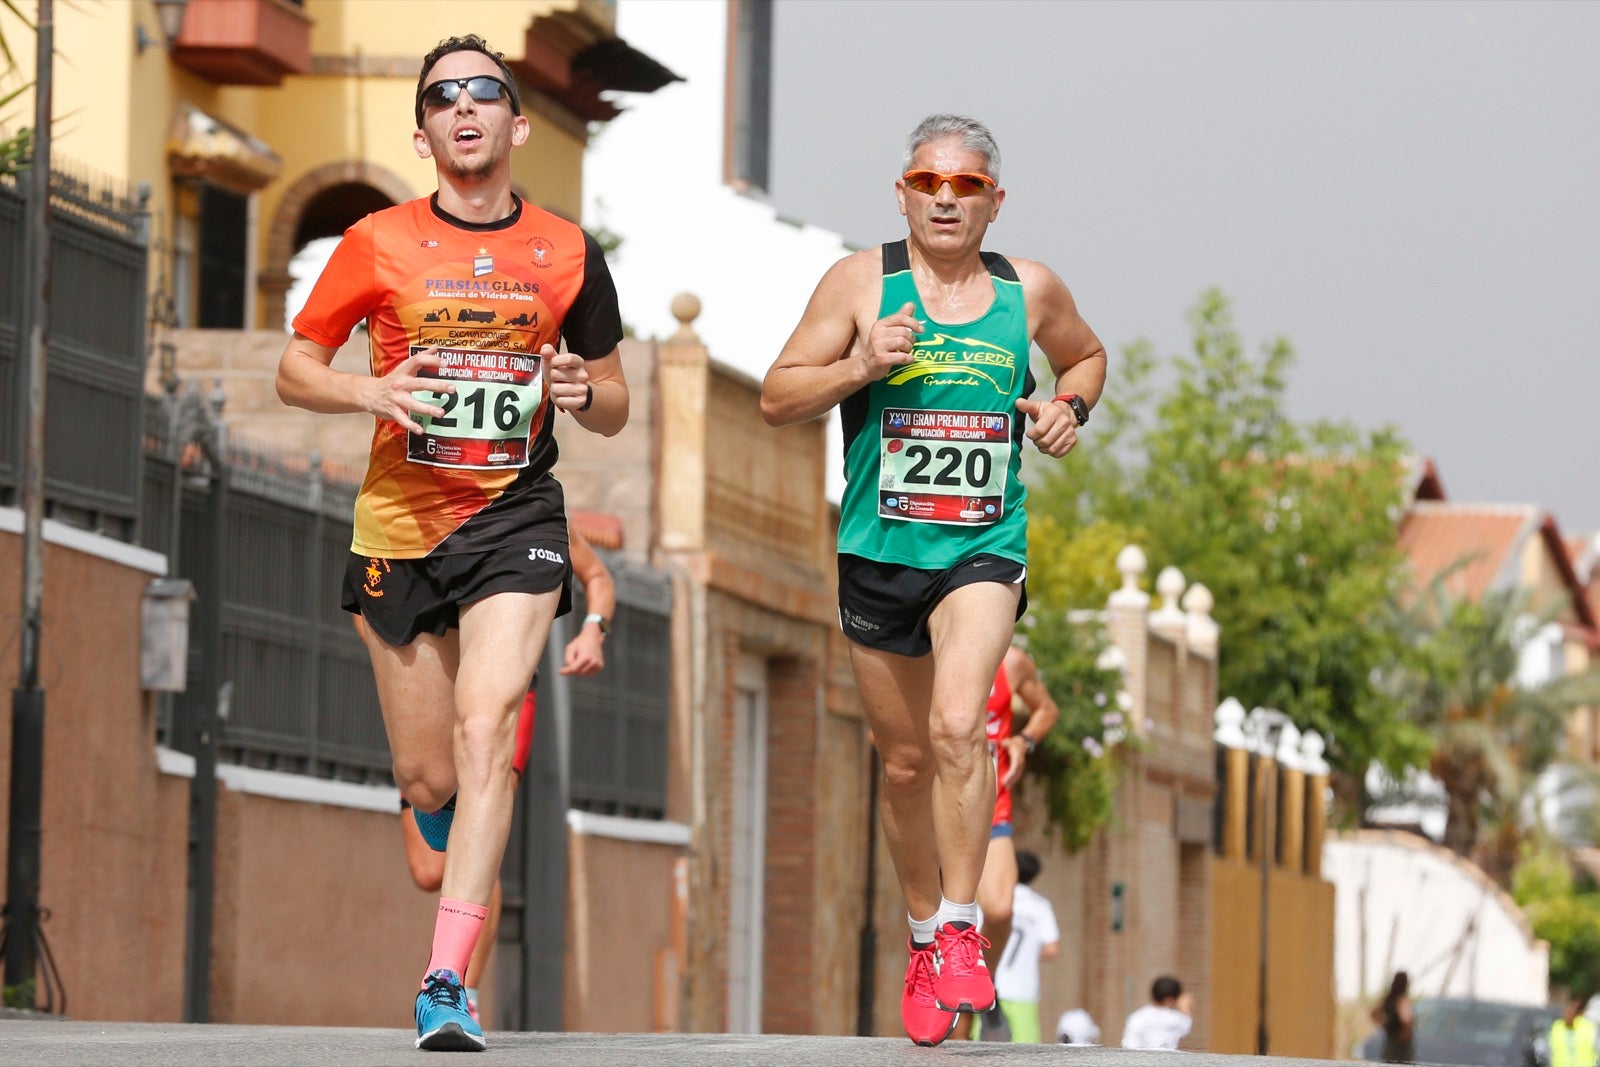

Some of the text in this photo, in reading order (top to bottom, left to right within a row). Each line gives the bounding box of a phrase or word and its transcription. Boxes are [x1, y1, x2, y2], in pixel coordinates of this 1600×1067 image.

[425, 279, 539, 293] PERSIALGLASS
[428, 290, 466, 298] Almacén
[480, 291, 508, 300] Vidrio
[510, 293, 533, 301] Plano
[448, 330, 510, 340] EXCAVACIONES
[441, 352, 463, 366] GRAN
[465, 353, 496, 369] PREMIO
[498, 356, 507, 369] DE
[509, 356, 535, 373] FONDO
[897, 349, 1015, 365] ENTE VERDE
[438, 367, 473, 378] DIPUTACIÓN
[478, 369, 514, 381] CRUZCAMPO
[923, 375, 980, 386] Granada
[431, 387, 521, 432] 216
[913, 413, 936, 427] GRAN
[937, 414, 968, 428] PREMIO
[970, 416, 979, 428] DE
[911, 427, 945, 437] DIPUTACIÓN
[950, 430, 986, 439] CRUZCAMPO
[903, 444, 992, 488] 220
